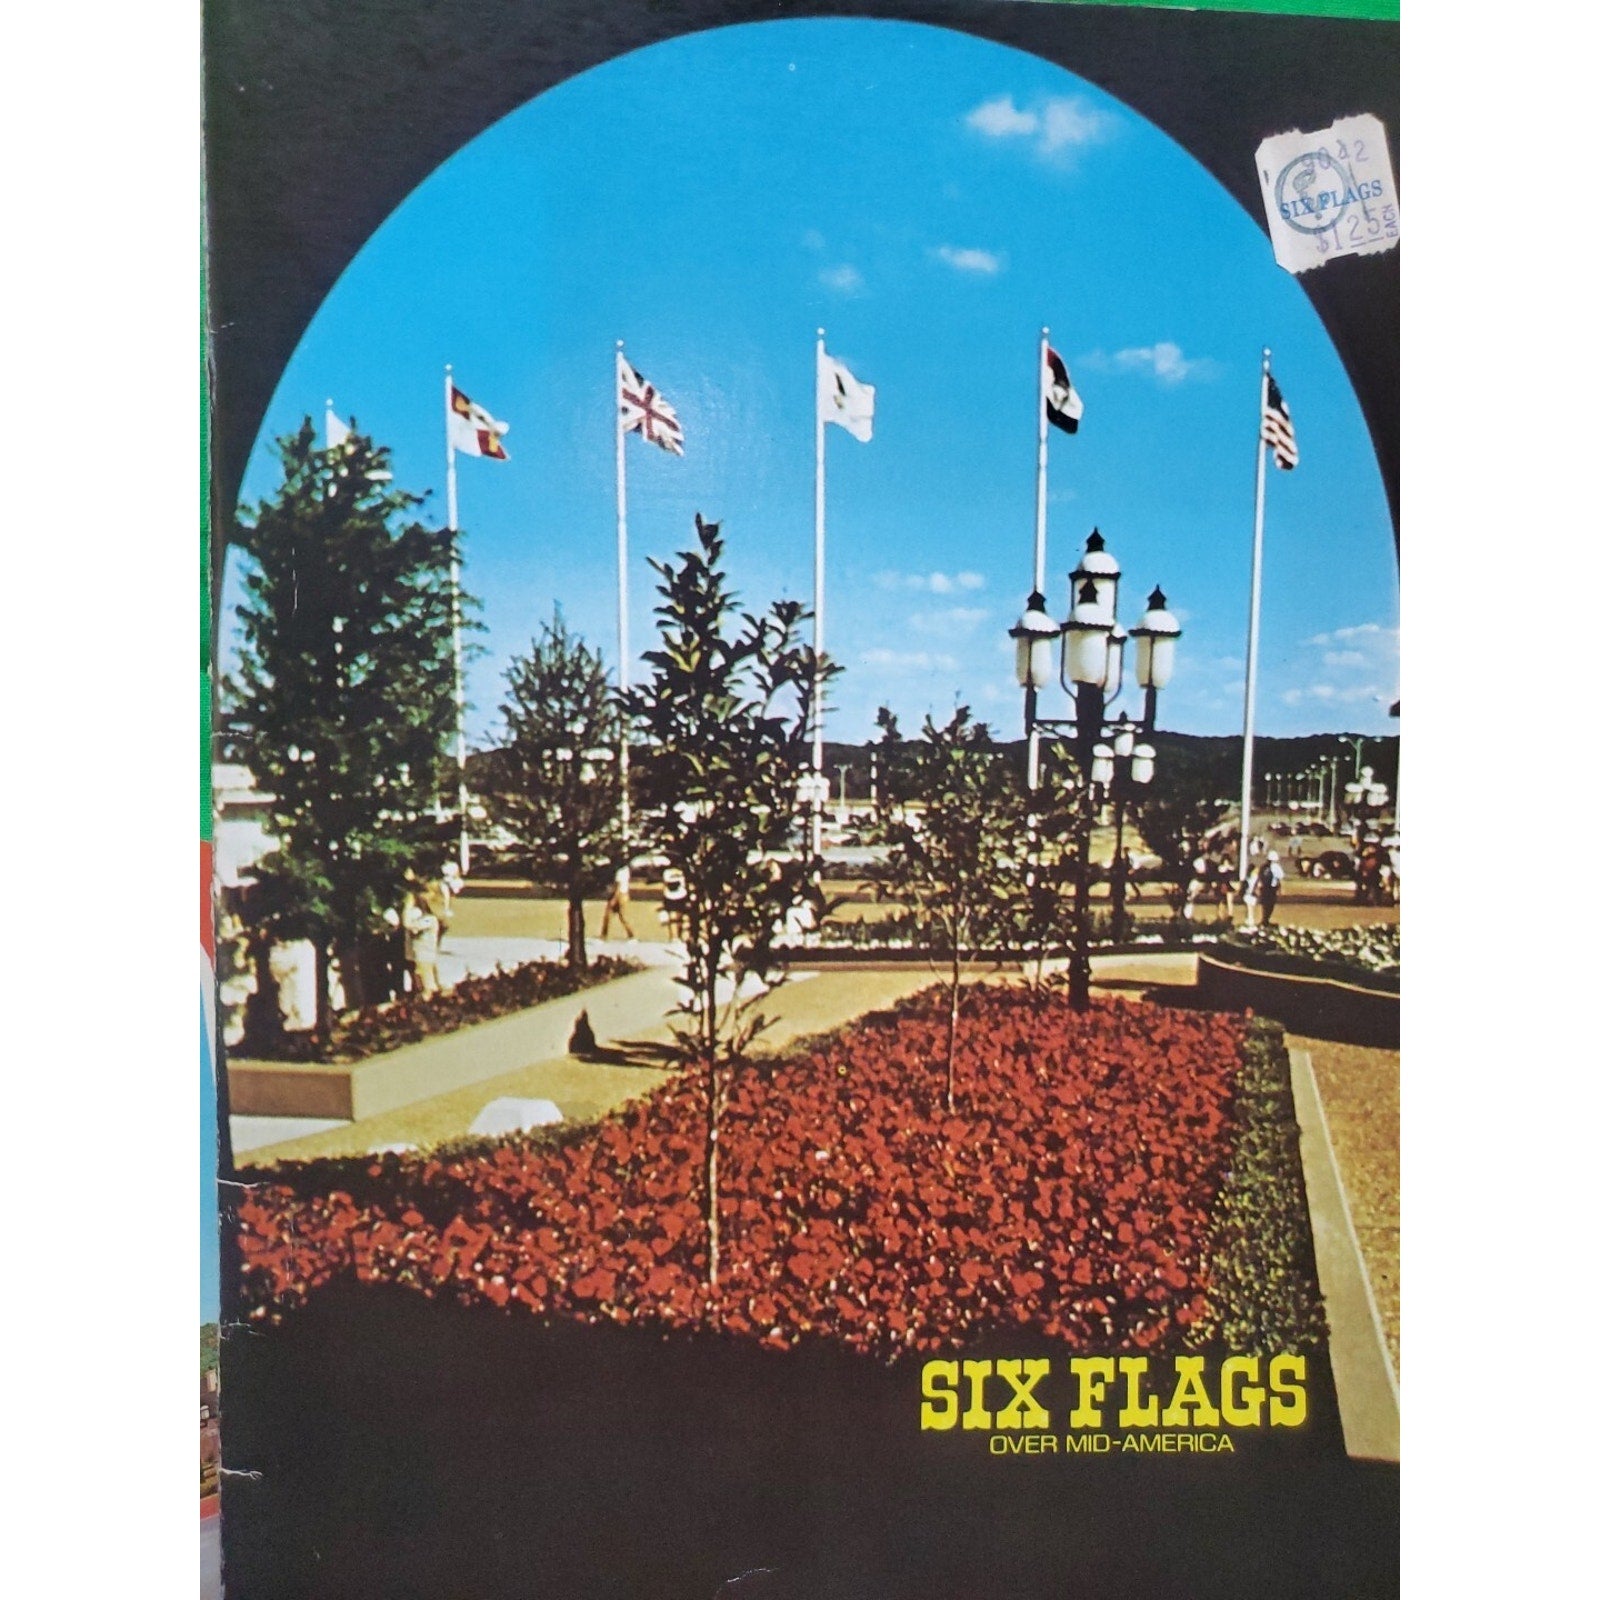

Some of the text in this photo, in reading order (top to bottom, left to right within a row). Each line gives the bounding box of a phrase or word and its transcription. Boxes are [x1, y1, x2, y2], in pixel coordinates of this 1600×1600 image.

[1280, 179, 1383, 220] SIX FLAGS
[920, 1354, 1307, 1431] SIX FLAGS
[989, 1433, 1235, 1455] OVER MID-AMERICA
